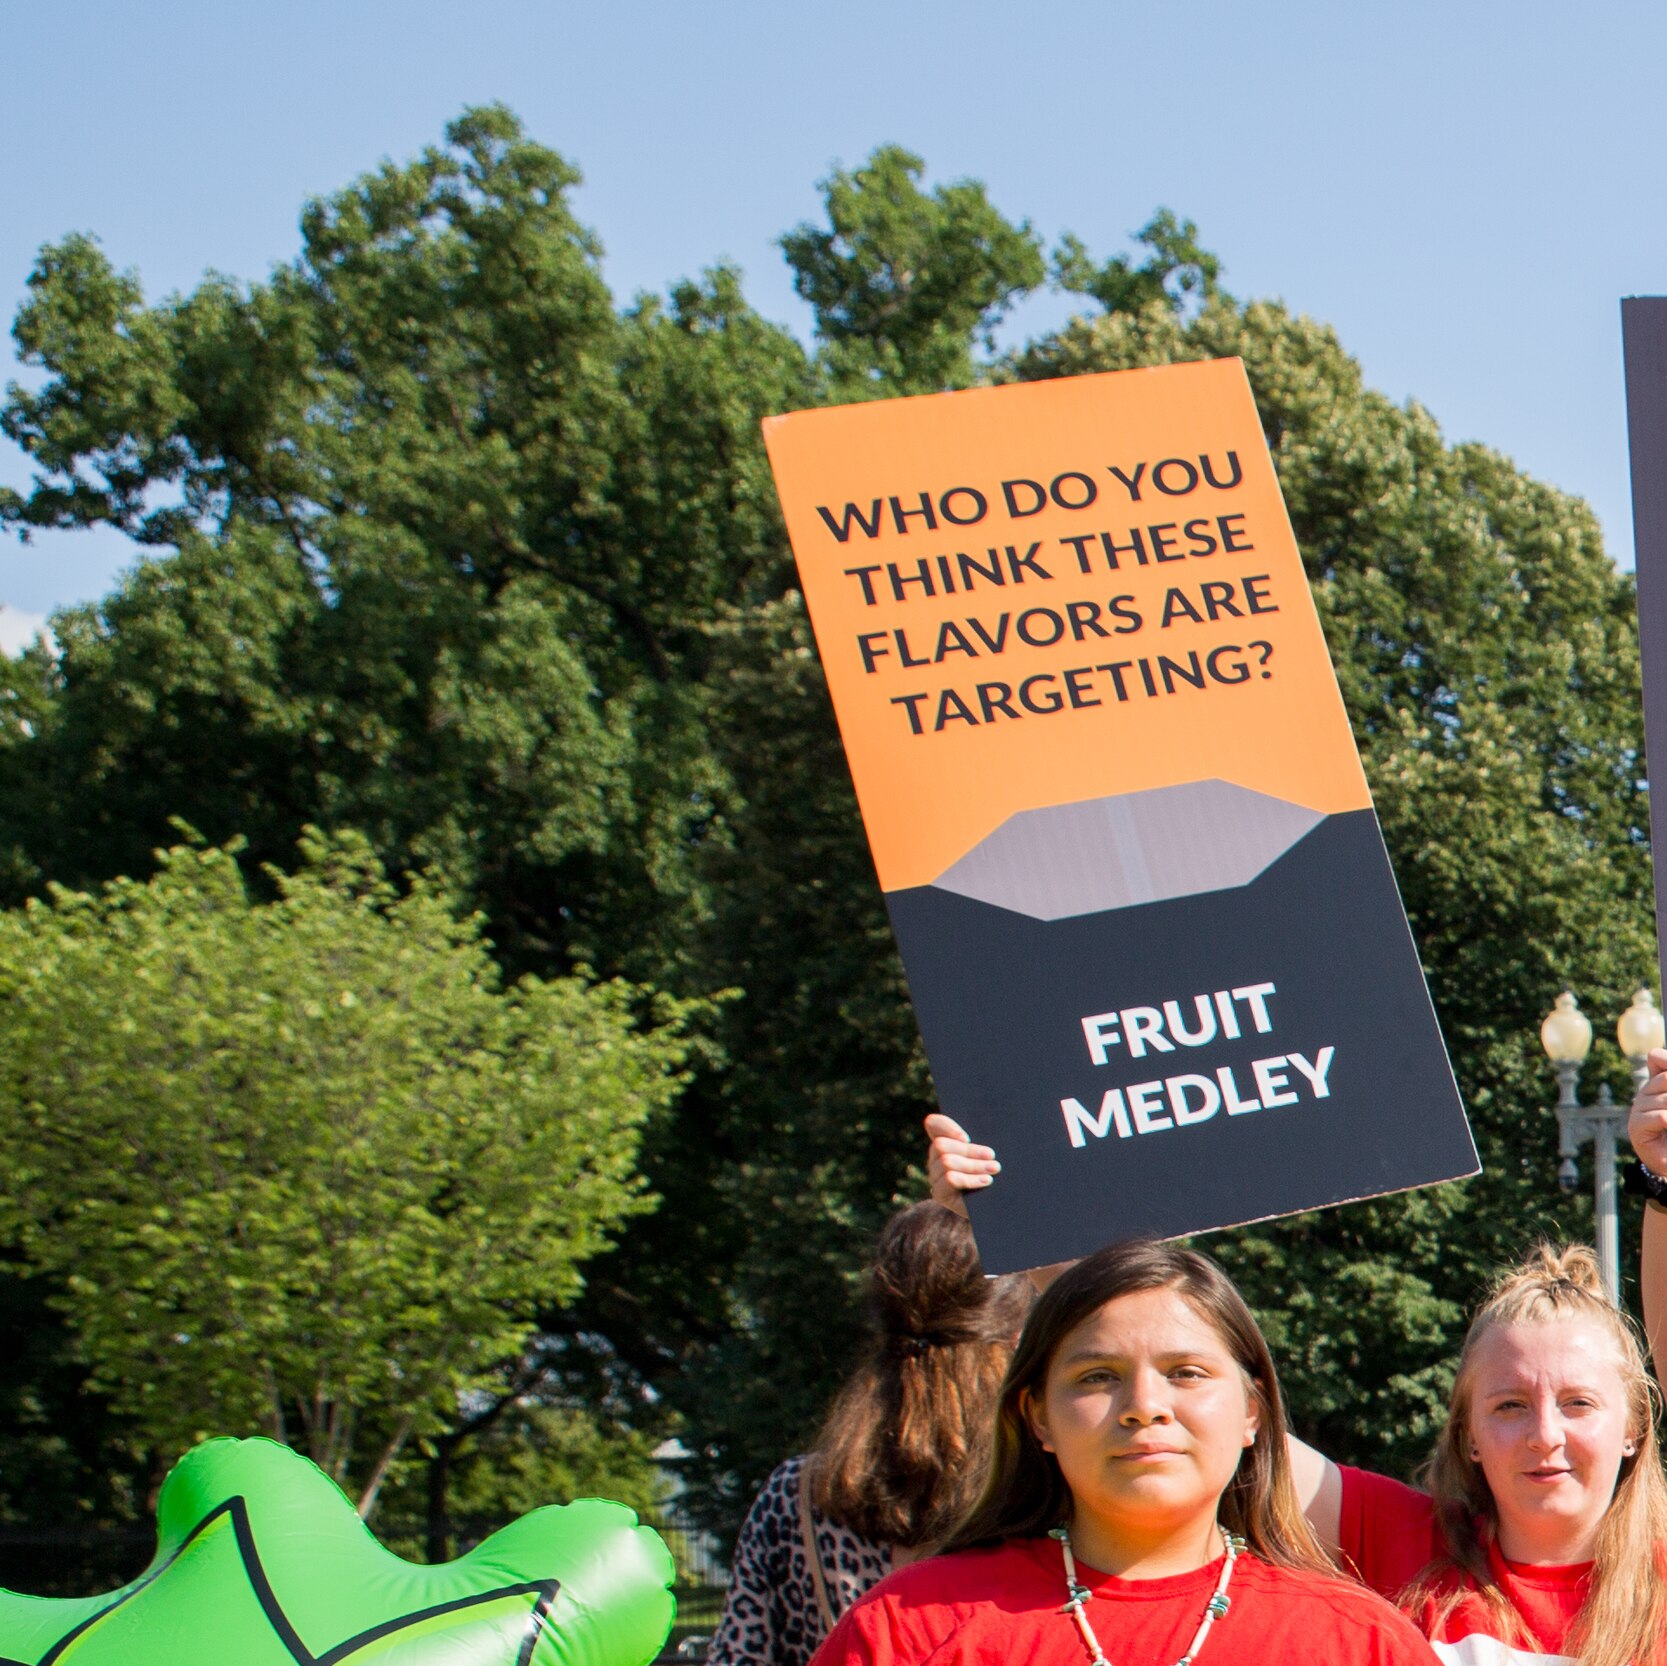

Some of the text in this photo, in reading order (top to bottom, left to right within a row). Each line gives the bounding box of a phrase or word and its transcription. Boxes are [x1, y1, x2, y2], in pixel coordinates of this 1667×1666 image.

[816, 451, 1242, 542] WHO DO YOU
[844, 514, 1255, 605] THINK THESE
[857, 575, 1279, 675] FLAVORS ARE
[890, 635, 1272, 734] TARGETING?
[1081, 981, 1278, 1066] FRUIT
[1061, 1041, 1334, 1147] MEDLEY
